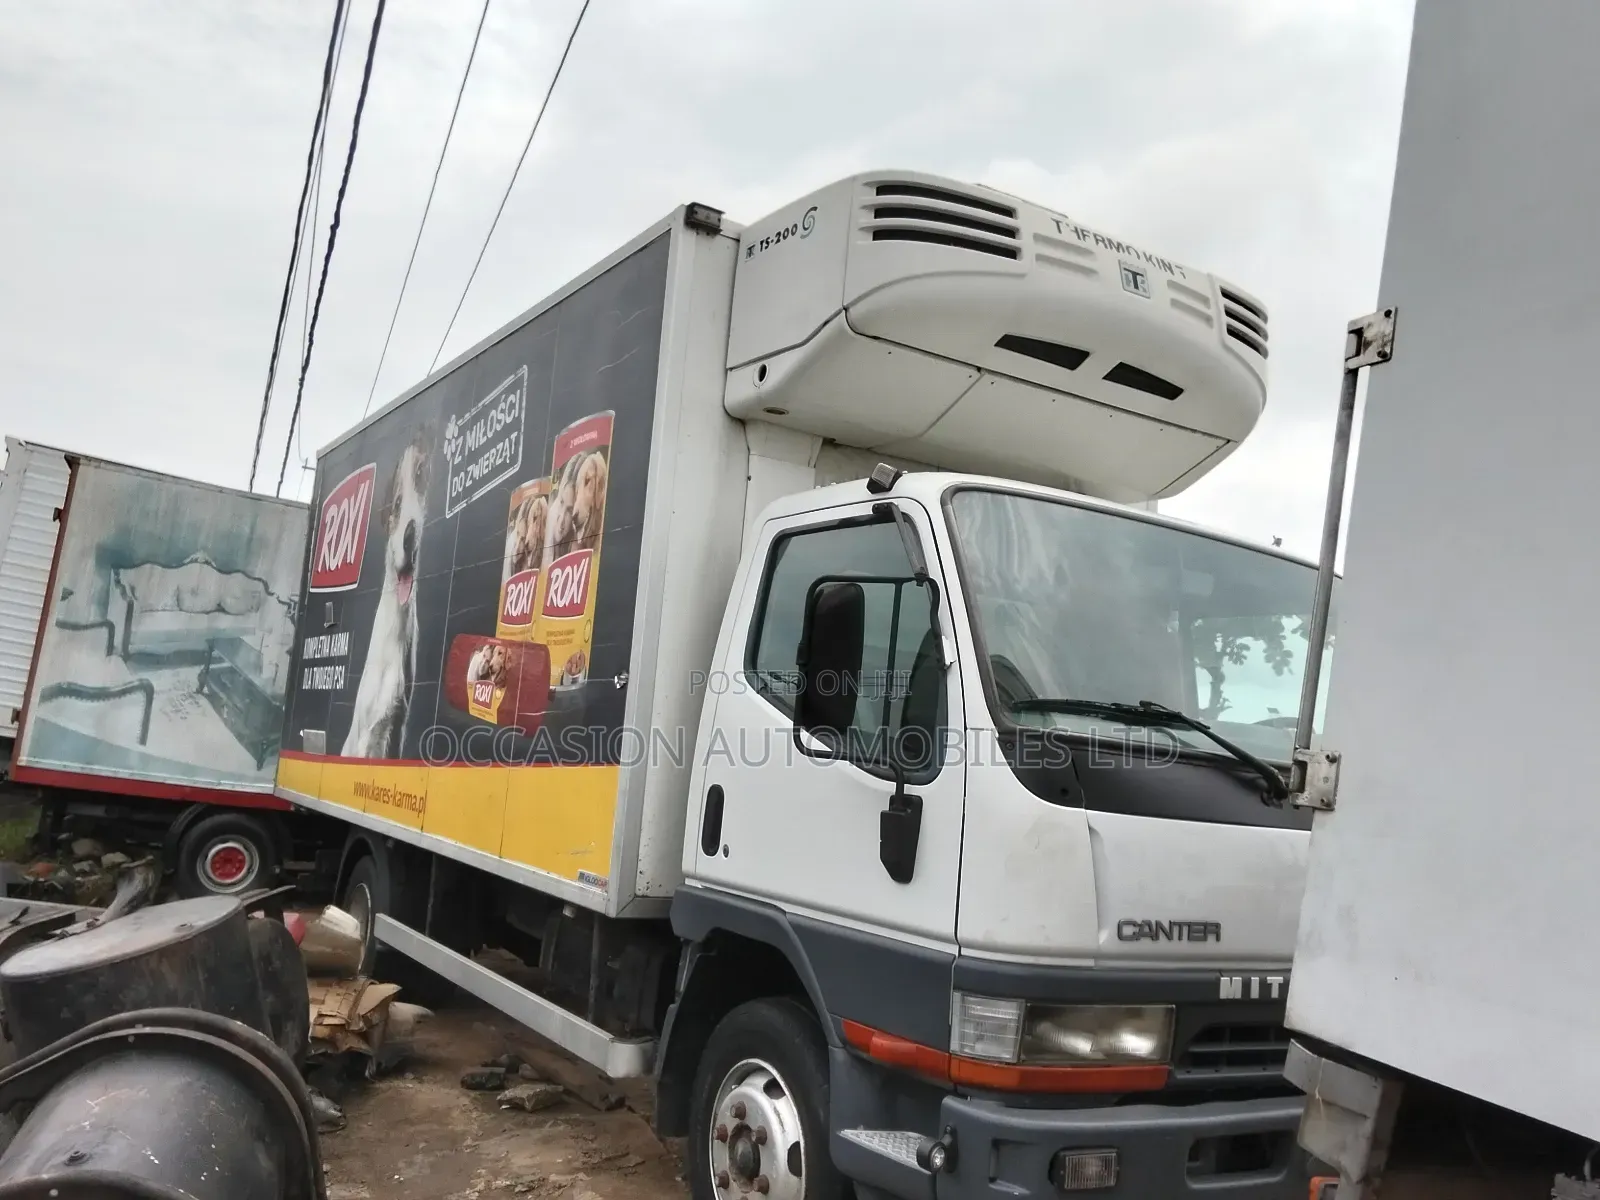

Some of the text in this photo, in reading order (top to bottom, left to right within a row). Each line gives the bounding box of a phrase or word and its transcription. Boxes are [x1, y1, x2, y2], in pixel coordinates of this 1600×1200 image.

[760, 224, 798, 252] TS-200
[465, 389, 521, 457] MIŁOŚCI
[451, 471, 465, 498] DO
[465, 431, 519, 488] ZWIERZĄT
[317, 480, 370, 573] ROXI
[504, 576, 536, 617] ROXI
[547, 557, 590, 608] ROXI
[333, 665, 346, 690] PSA
[474, 683, 493, 704] ROXI
[353, 779, 428, 819] www.kares-karma.pl
[1117, 919, 1222, 942] CANTER
